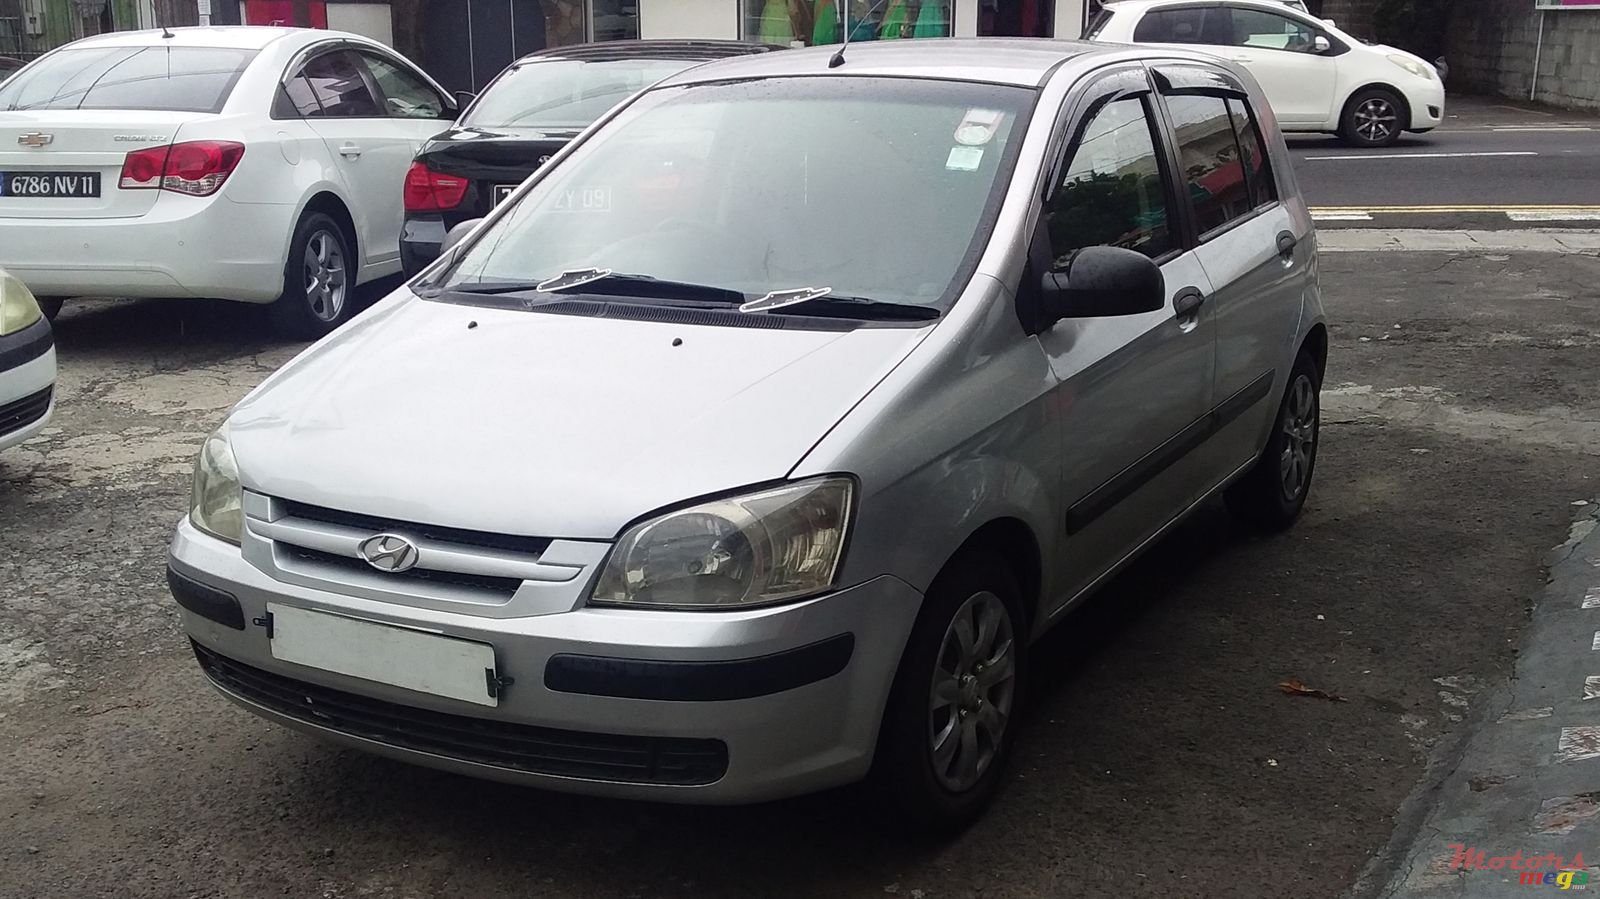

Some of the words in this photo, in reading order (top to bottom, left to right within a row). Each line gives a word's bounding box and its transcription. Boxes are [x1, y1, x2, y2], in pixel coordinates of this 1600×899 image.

[11, 176, 51, 194] 6786
[54, 176, 78, 194] NV
[81, 176, 94, 194] 11
[583, 189, 604, 208] 09
